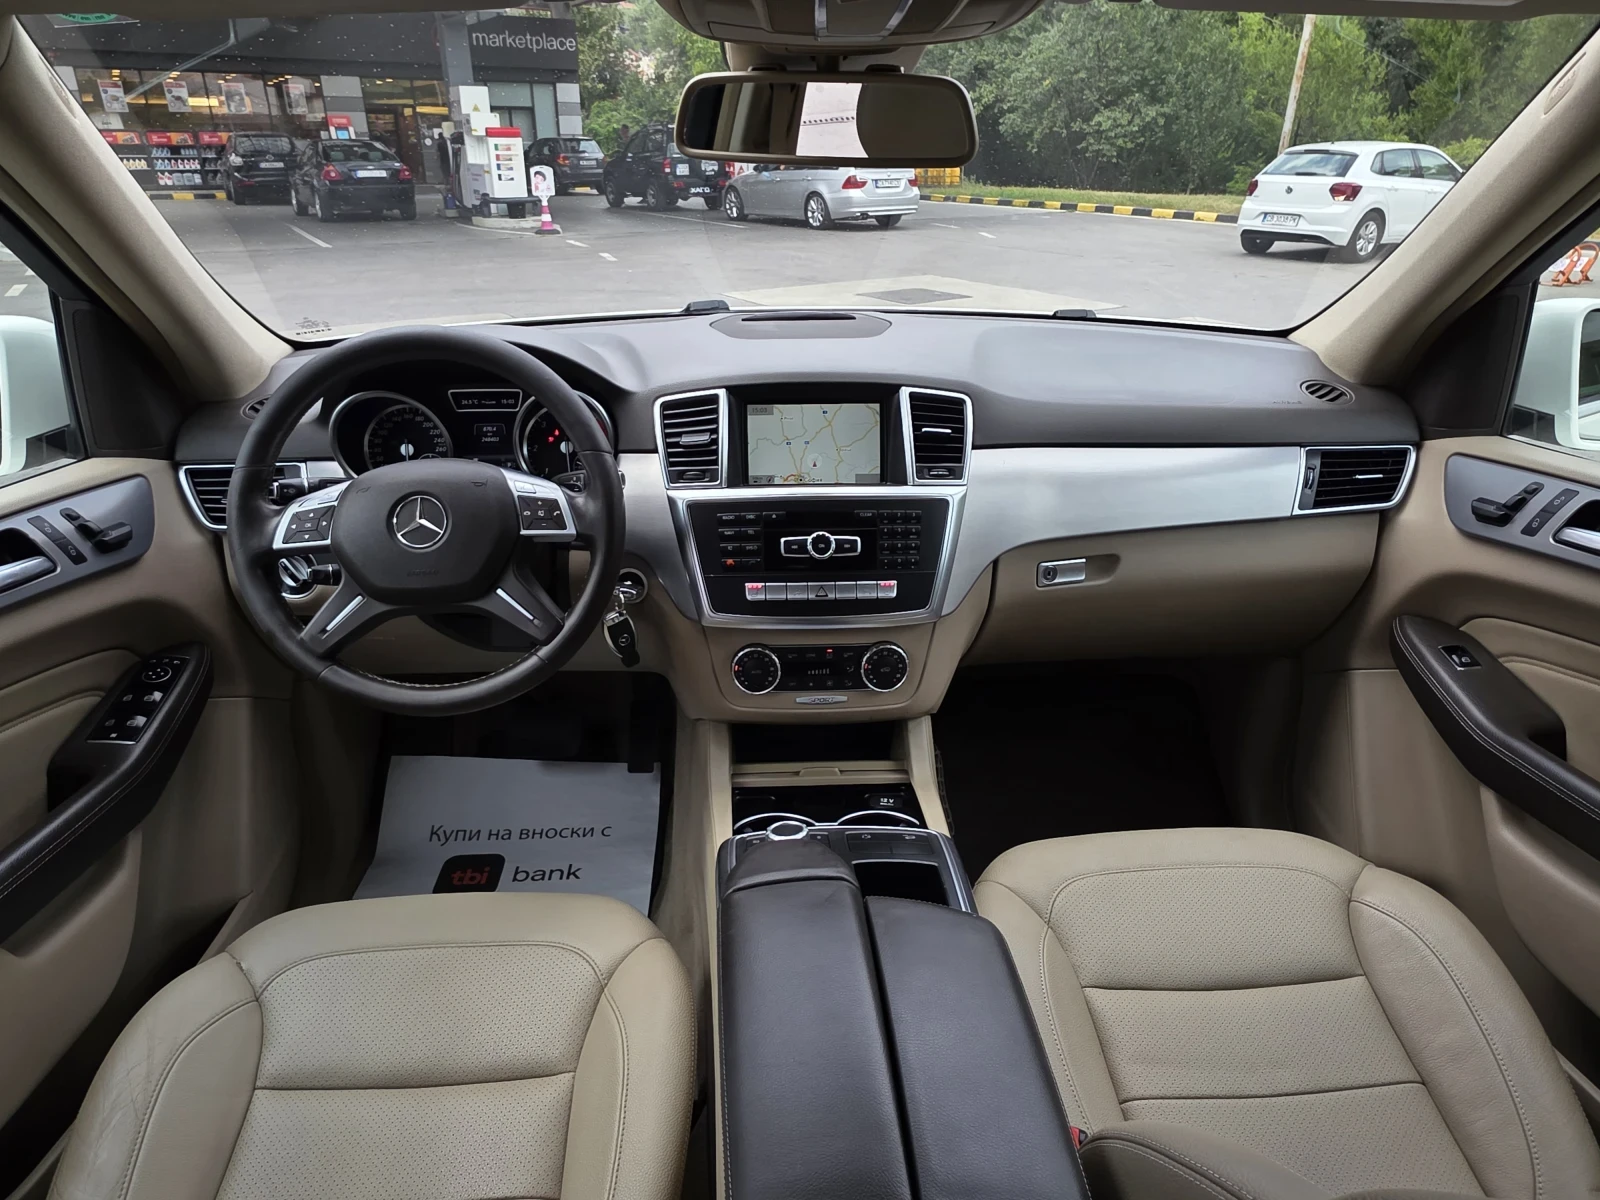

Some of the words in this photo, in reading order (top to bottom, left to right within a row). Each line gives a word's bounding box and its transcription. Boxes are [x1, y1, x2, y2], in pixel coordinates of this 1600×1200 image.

[472, 30, 576, 53] marketplace
[429, 825, 481, 847] Купи
[488, 828, 512, 841] на
[518, 825, 595, 840] вноски
[601, 825, 612, 837] с
[451, 867, 491, 885] tbi
[512, 864, 582, 882] bank
